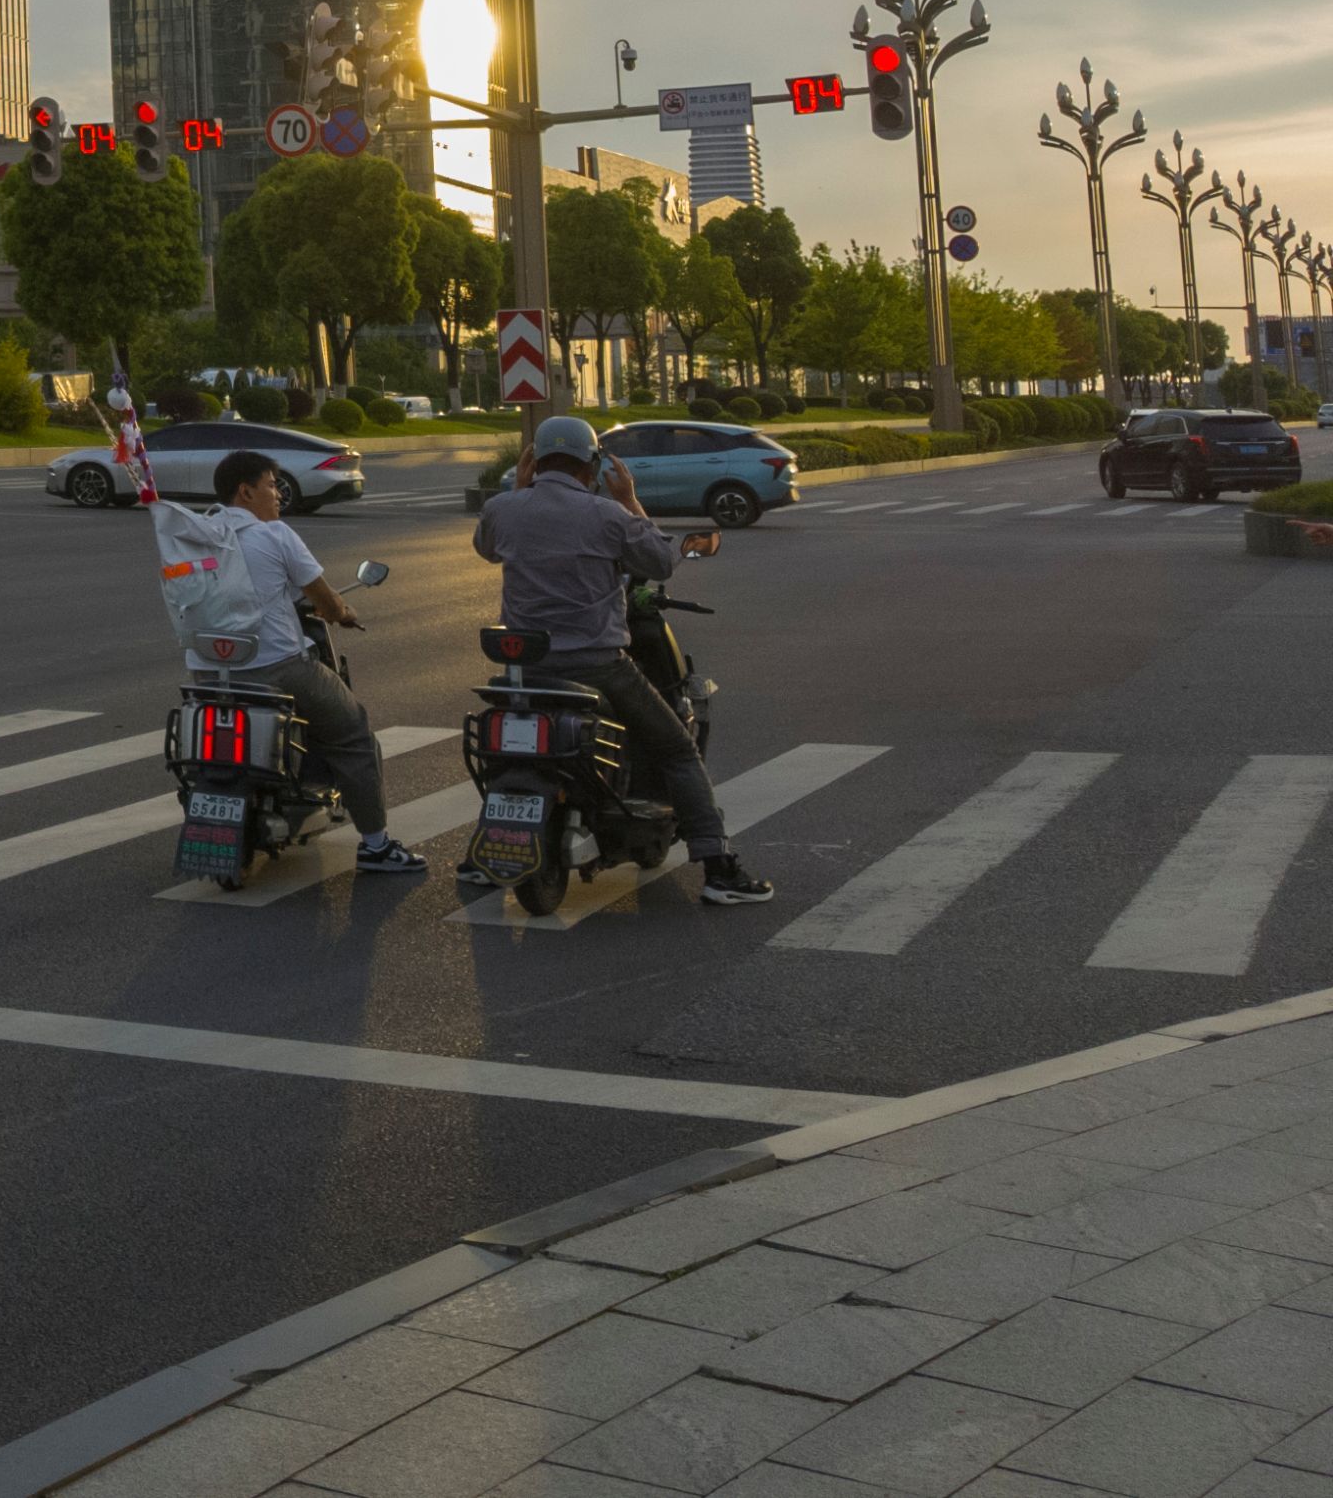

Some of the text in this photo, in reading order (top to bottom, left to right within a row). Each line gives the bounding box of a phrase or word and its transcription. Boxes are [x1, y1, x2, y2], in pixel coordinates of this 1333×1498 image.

[792, 77, 842, 114] 04
[79, 124, 116, 154] 04
[184, 119, 223, 151] 04
[276, 119, 307, 144] 70
[952, 213, 971, 226] 40
[191, 802, 234, 819] S5481
[488, 803, 533, 821] BU024
